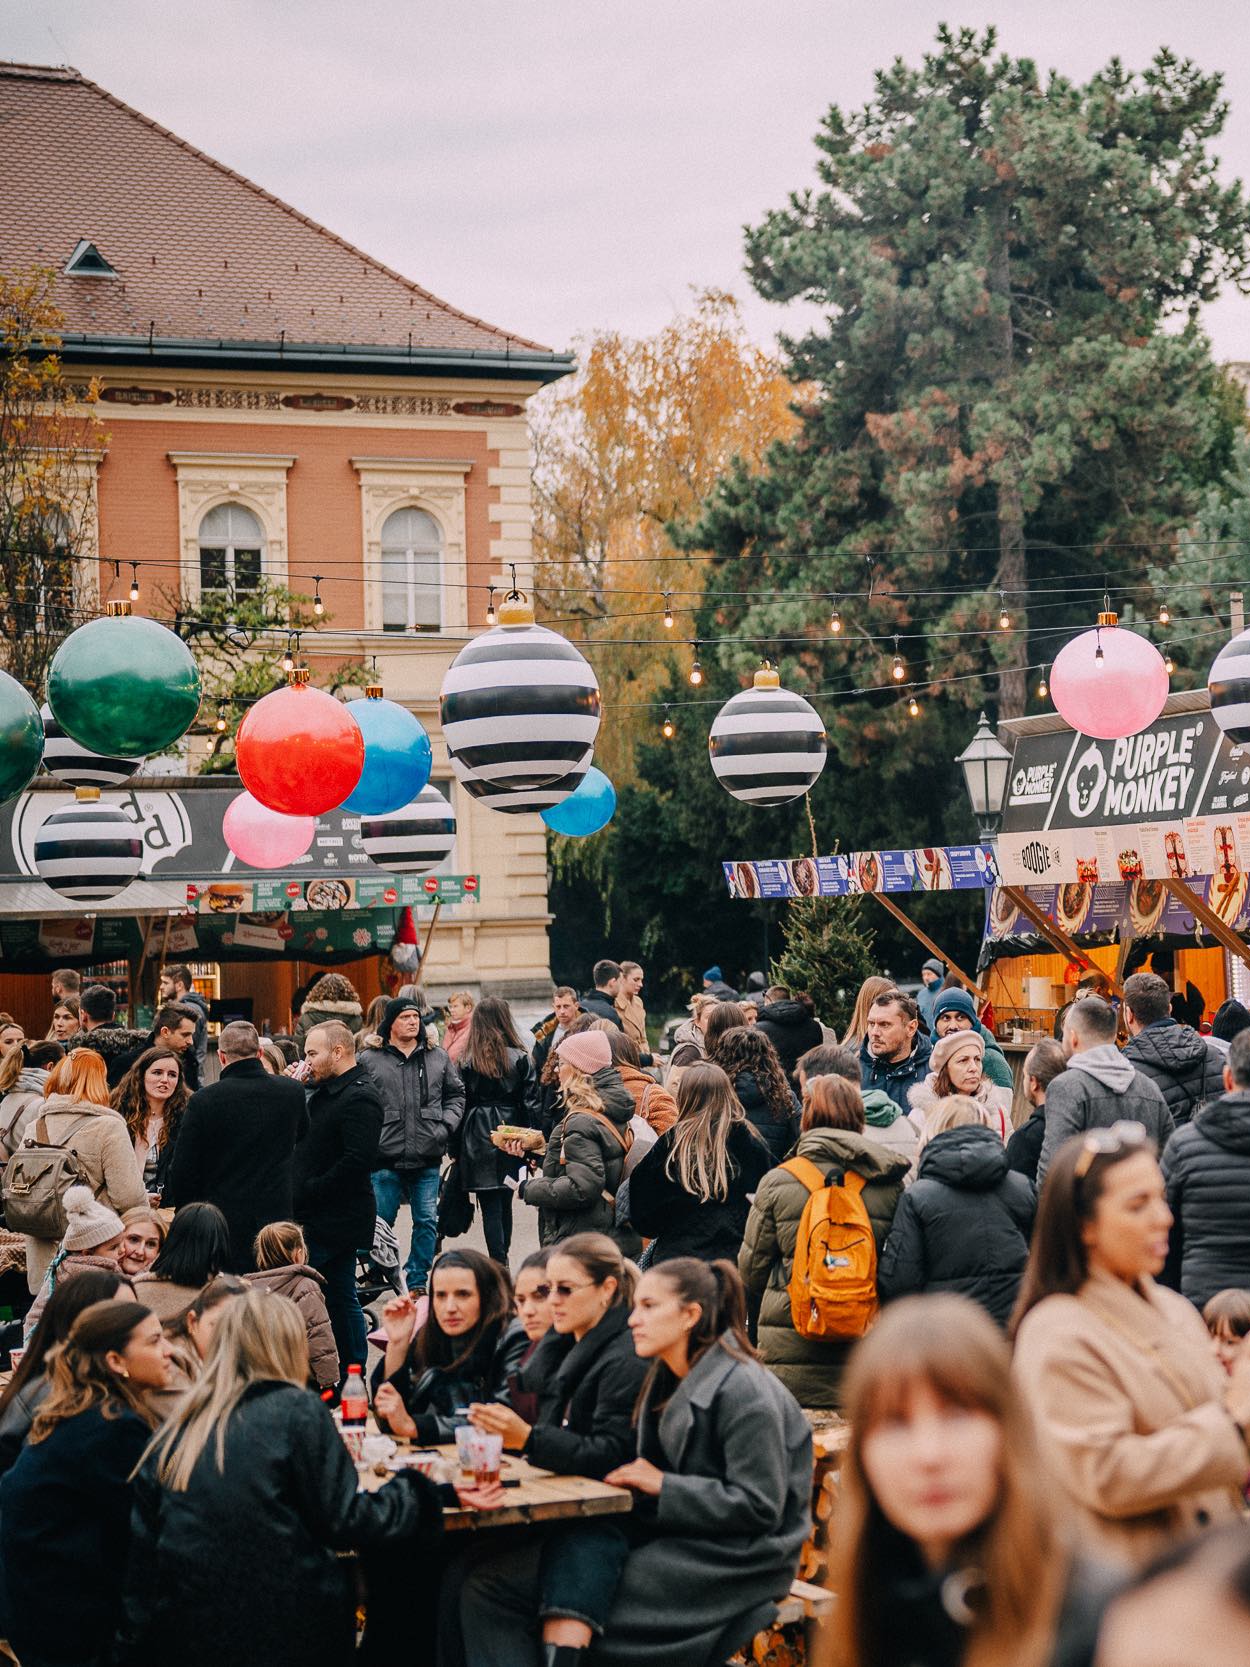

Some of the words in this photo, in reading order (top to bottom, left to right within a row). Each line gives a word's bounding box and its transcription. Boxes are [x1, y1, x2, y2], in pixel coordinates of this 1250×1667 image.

[1110, 728, 1193, 778] PURPLE
[1025, 779, 1055, 796] MONKEY
[1027, 764, 1055, 783] PURPLE
[1104, 765, 1195, 816] MONKEY
[1022, 841, 1051, 874] BOOGIE
